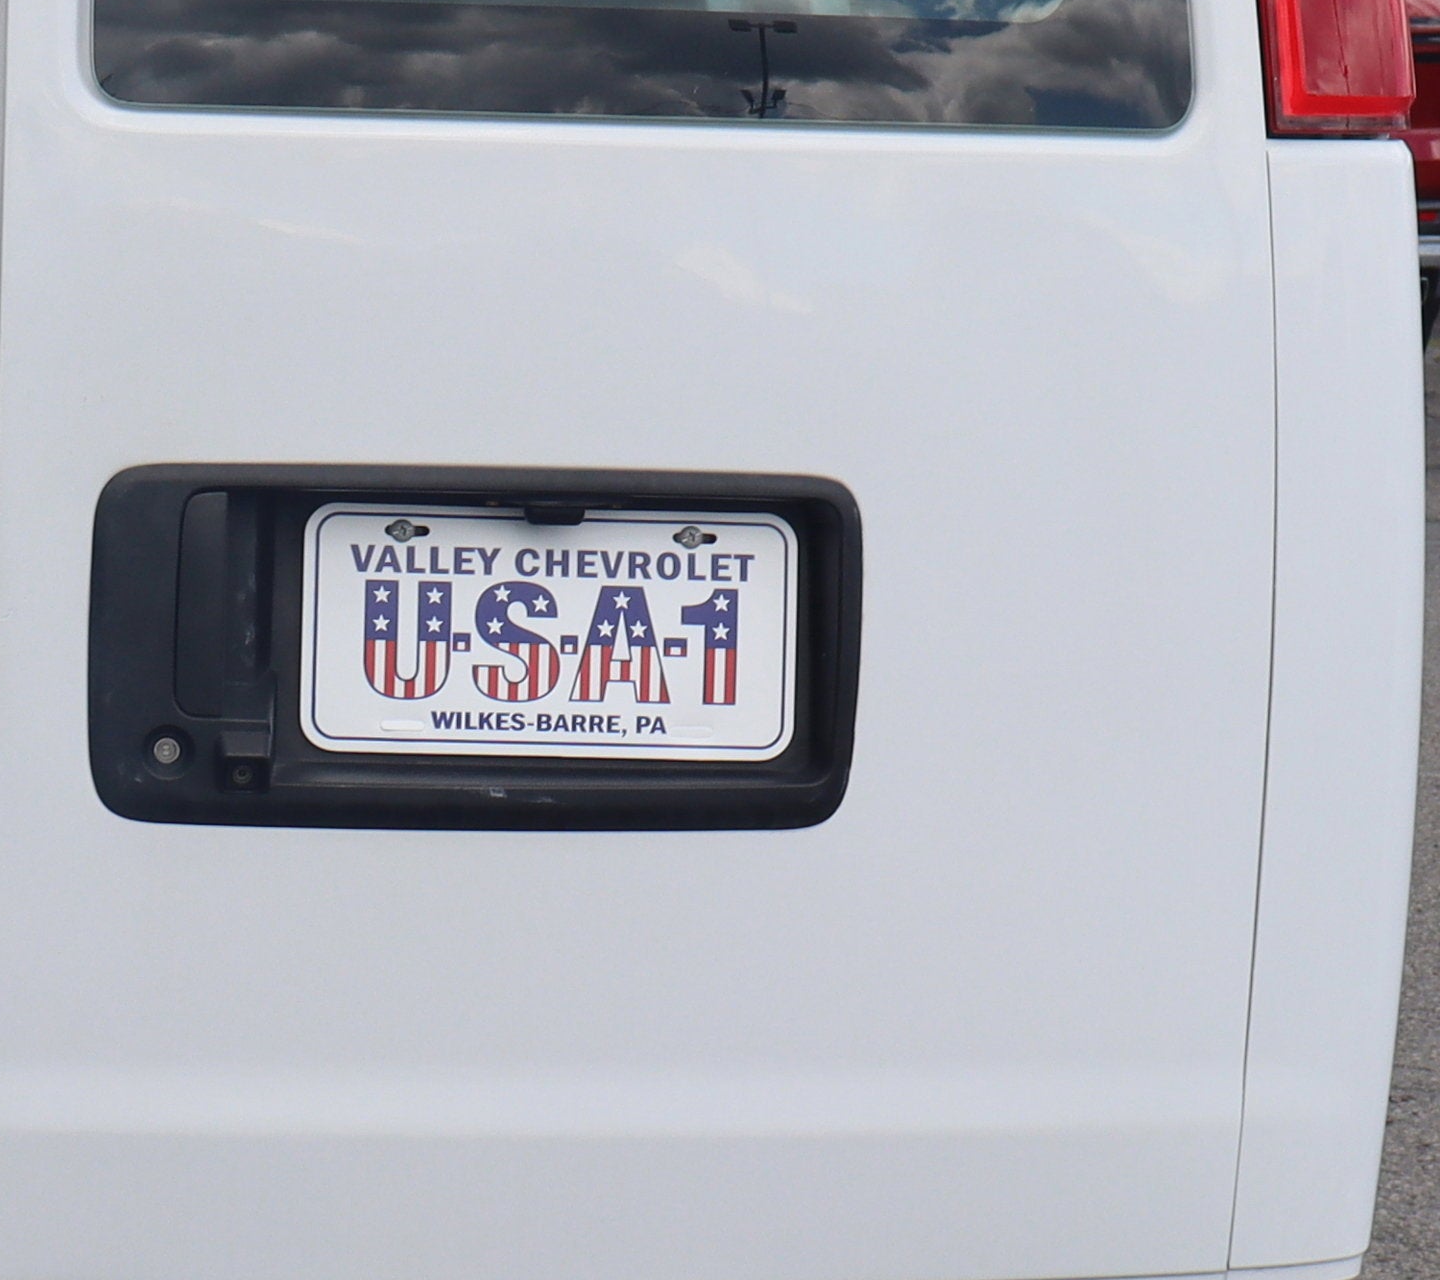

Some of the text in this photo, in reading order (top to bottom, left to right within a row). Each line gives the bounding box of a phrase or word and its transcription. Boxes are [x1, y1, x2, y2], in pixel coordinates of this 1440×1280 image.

[350, 544, 756, 583] VALLEY CHEVROLET
[430, 710, 668, 738] WILKES-BARRE, PA
